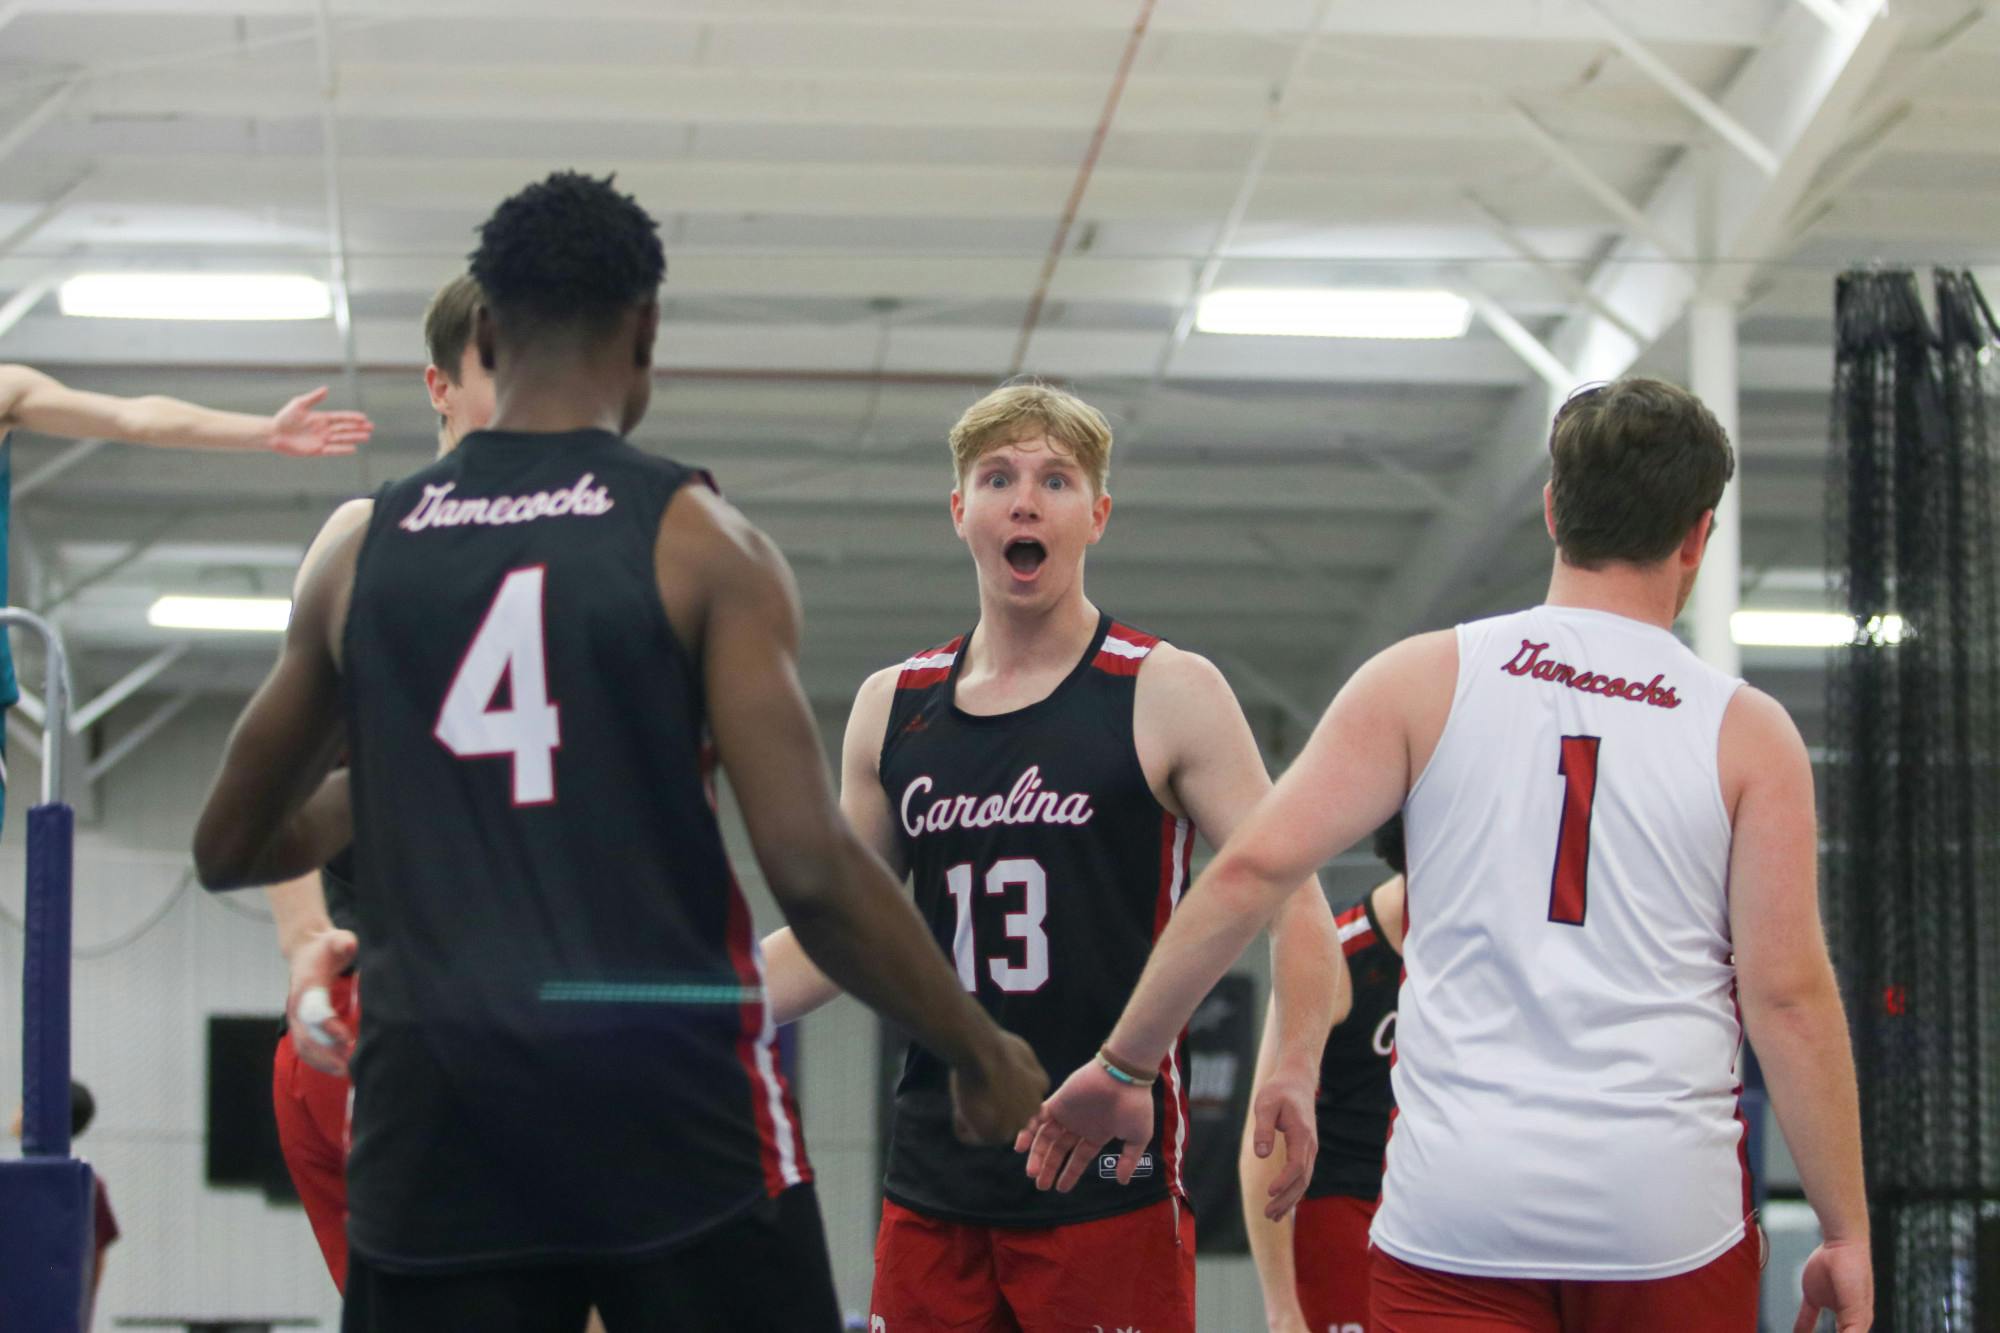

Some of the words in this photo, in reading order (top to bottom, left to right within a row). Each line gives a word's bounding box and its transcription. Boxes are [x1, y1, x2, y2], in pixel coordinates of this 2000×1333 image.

[400, 472, 613, 531] Gamecocks
[434, 564, 561, 807] 4
[1501, 640, 1681, 708] Gamecocks
[902, 766, 1093, 836] Carolina
[1548, 735, 1601, 926] 1
[946, 858, 1050, 993] 13
